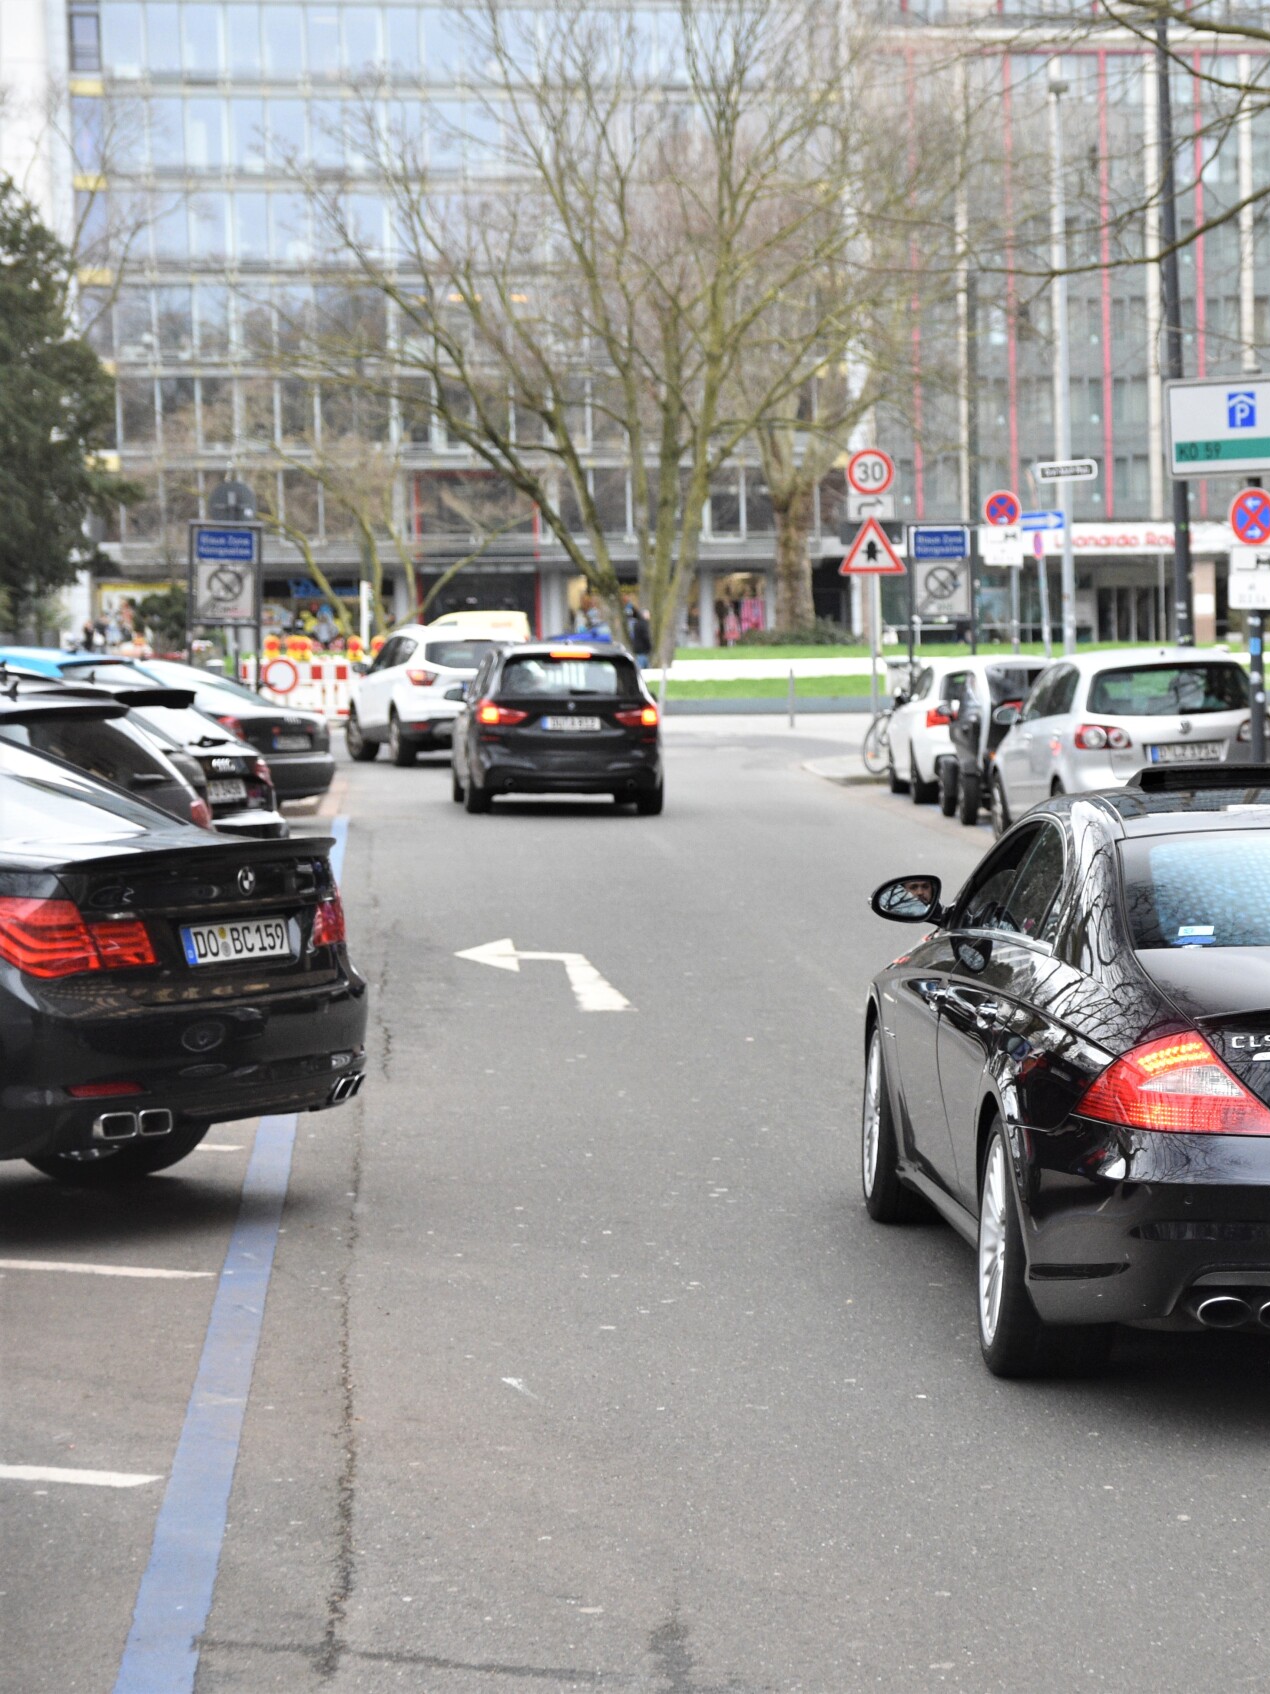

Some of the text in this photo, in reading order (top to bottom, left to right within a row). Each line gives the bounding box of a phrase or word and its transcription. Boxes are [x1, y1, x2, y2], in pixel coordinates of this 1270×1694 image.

[1205, 442, 1222, 459] 59
[857, 461, 884, 482] 30
[193, 923, 284, 958] DO BC 159
